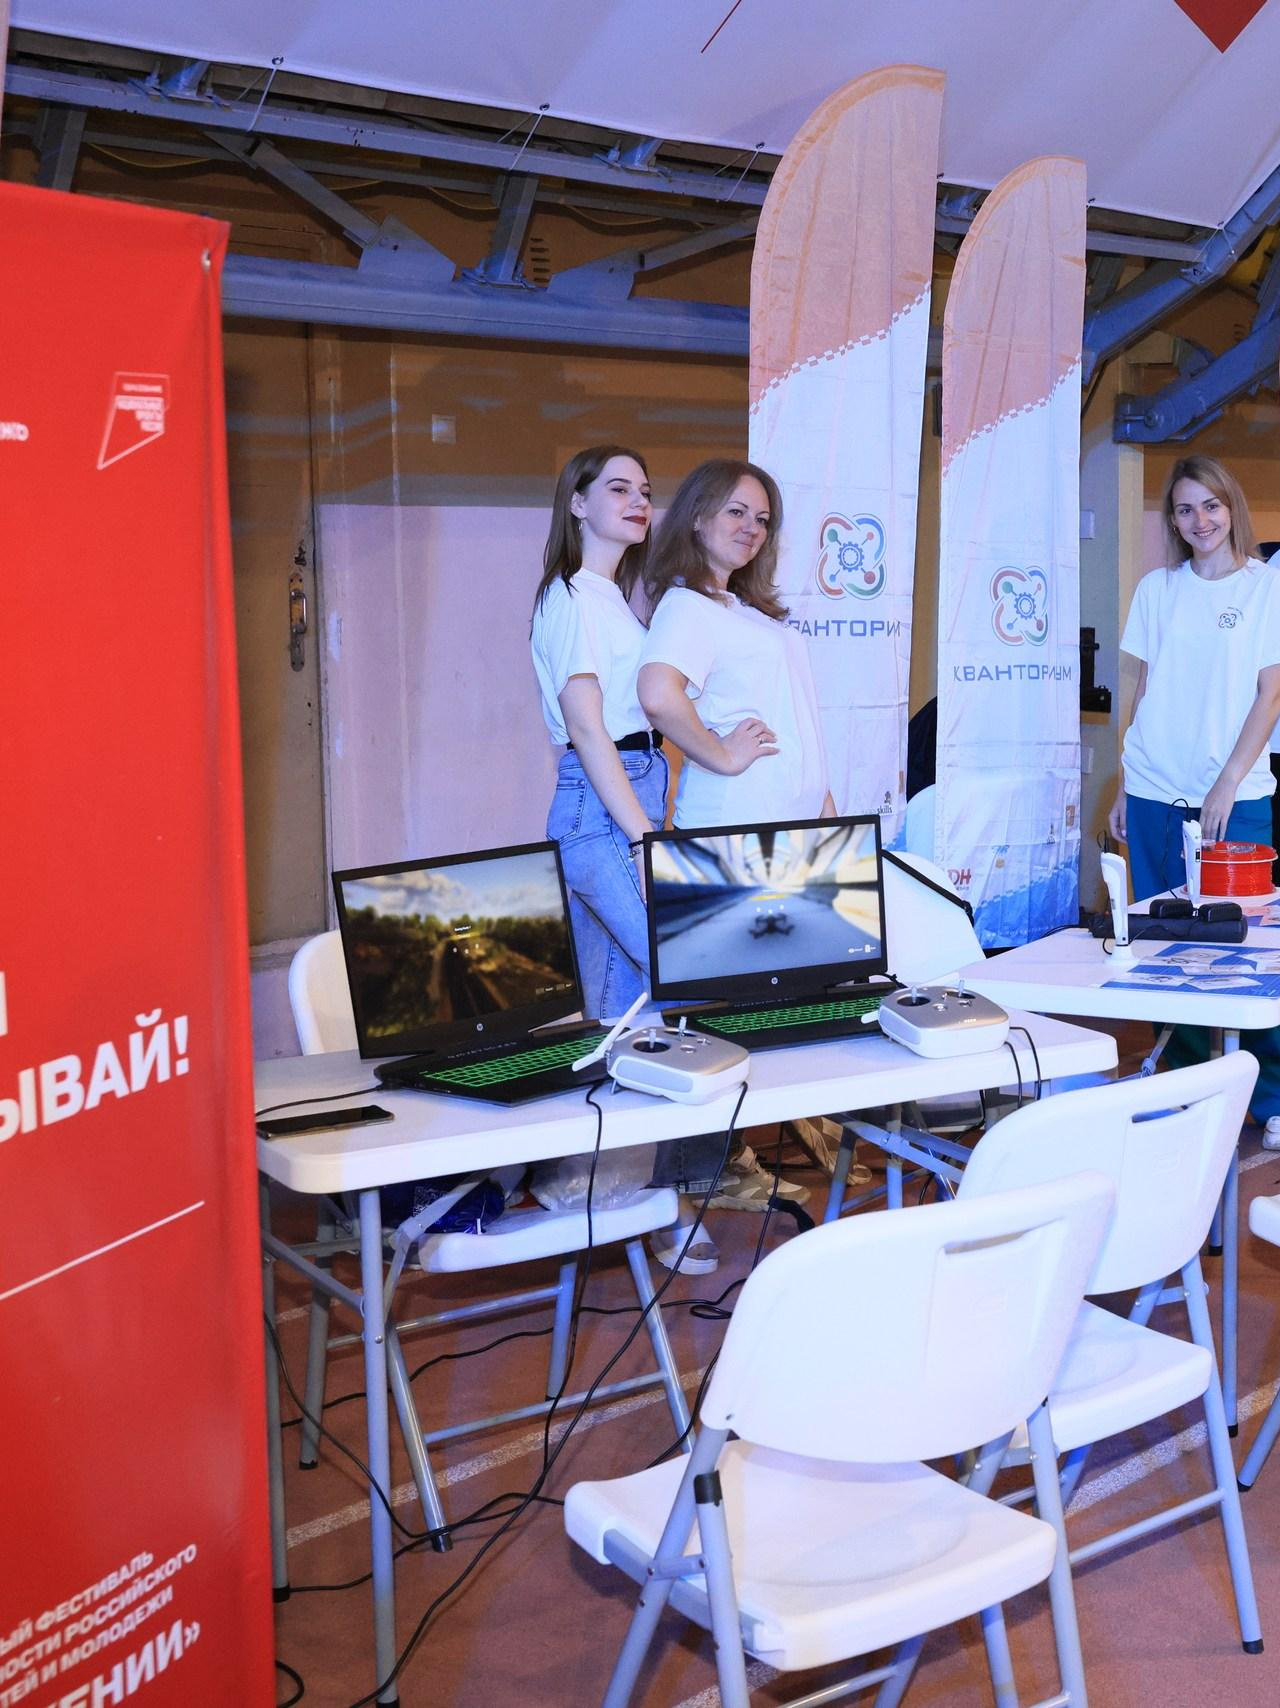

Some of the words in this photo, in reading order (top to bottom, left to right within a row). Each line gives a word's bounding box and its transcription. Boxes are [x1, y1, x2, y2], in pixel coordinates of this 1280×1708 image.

[953, 664, 1072, 682] КВАНТОРИУМ
[35, 1551, 154, 1632] ФЕСТИВАЛЬ
[60, 1585, 174, 1674] МОЛОДЕЖИ
[64, 1544, 198, 1645] РОССИЙСКОГО
